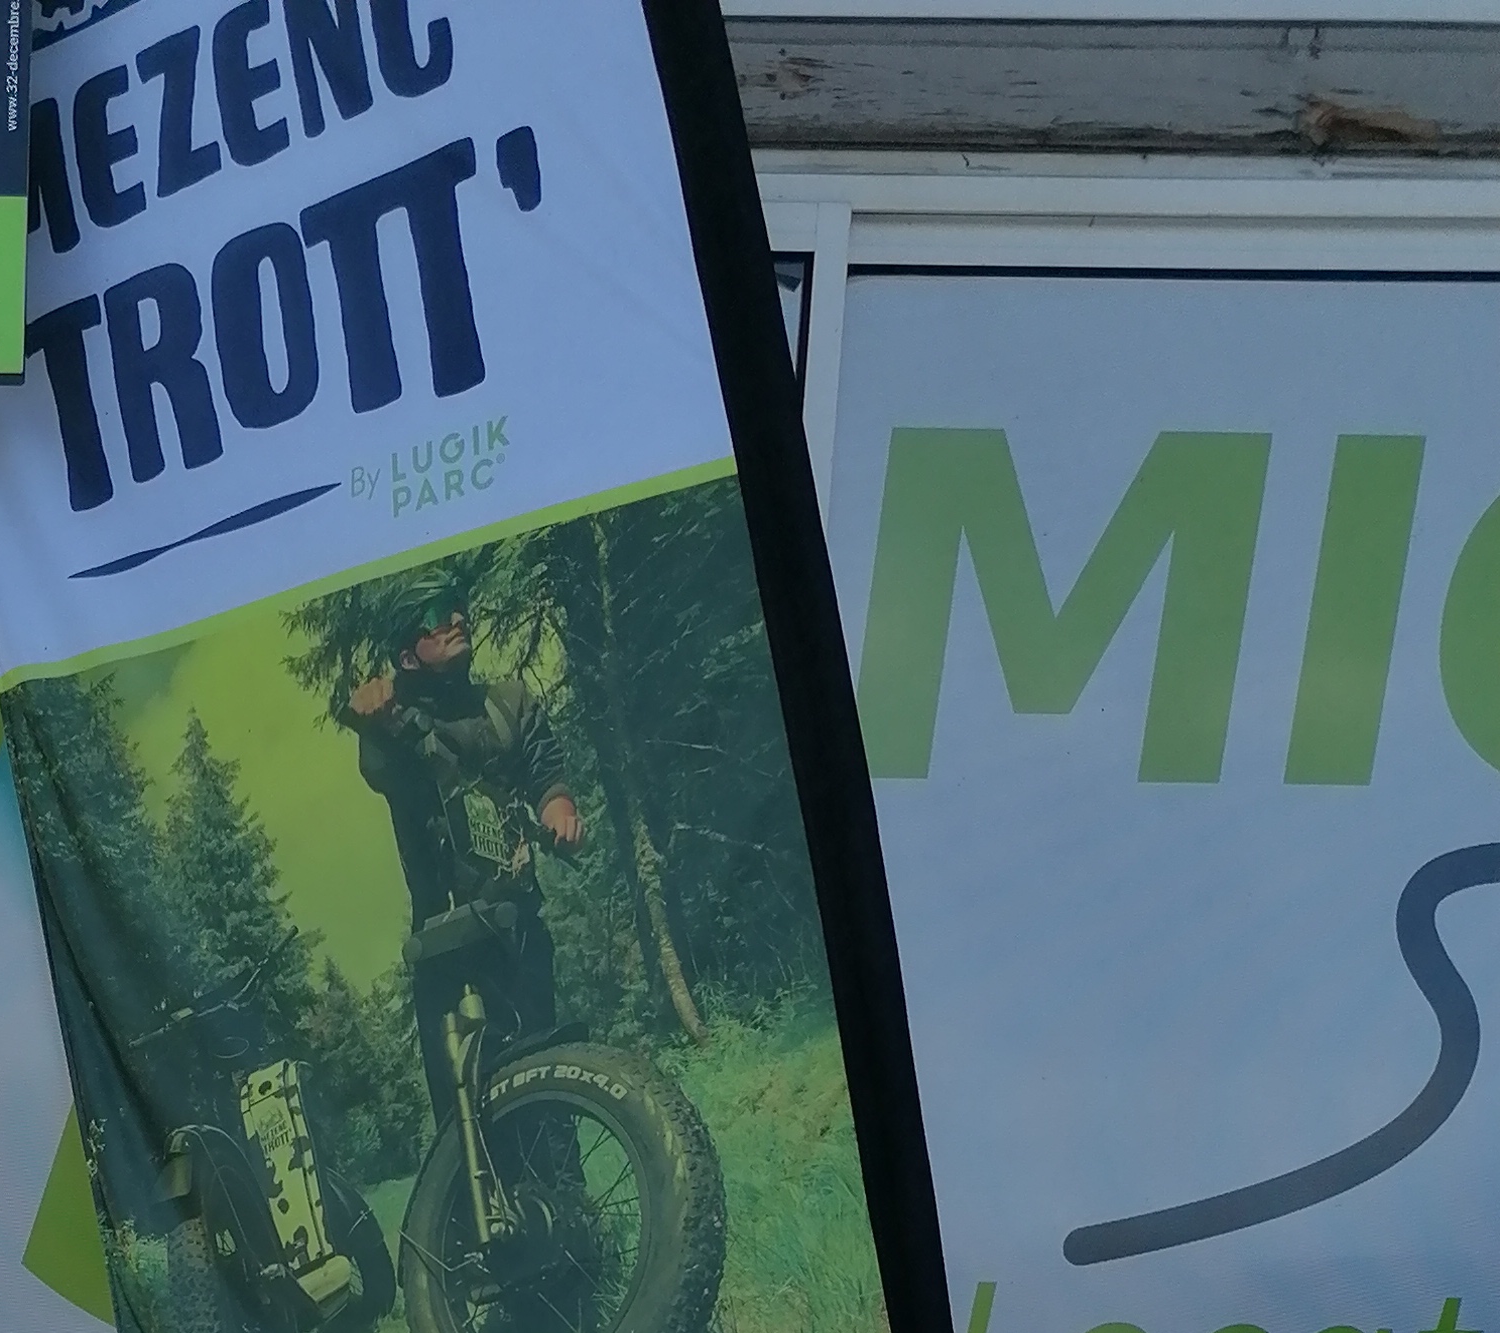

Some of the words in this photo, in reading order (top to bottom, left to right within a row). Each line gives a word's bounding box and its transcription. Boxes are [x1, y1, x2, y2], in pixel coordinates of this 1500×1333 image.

[25, 125, 542, 513] TROTT'
[351, 466, 381, 500] By
[391, 415, 510, 482] LUGIK
